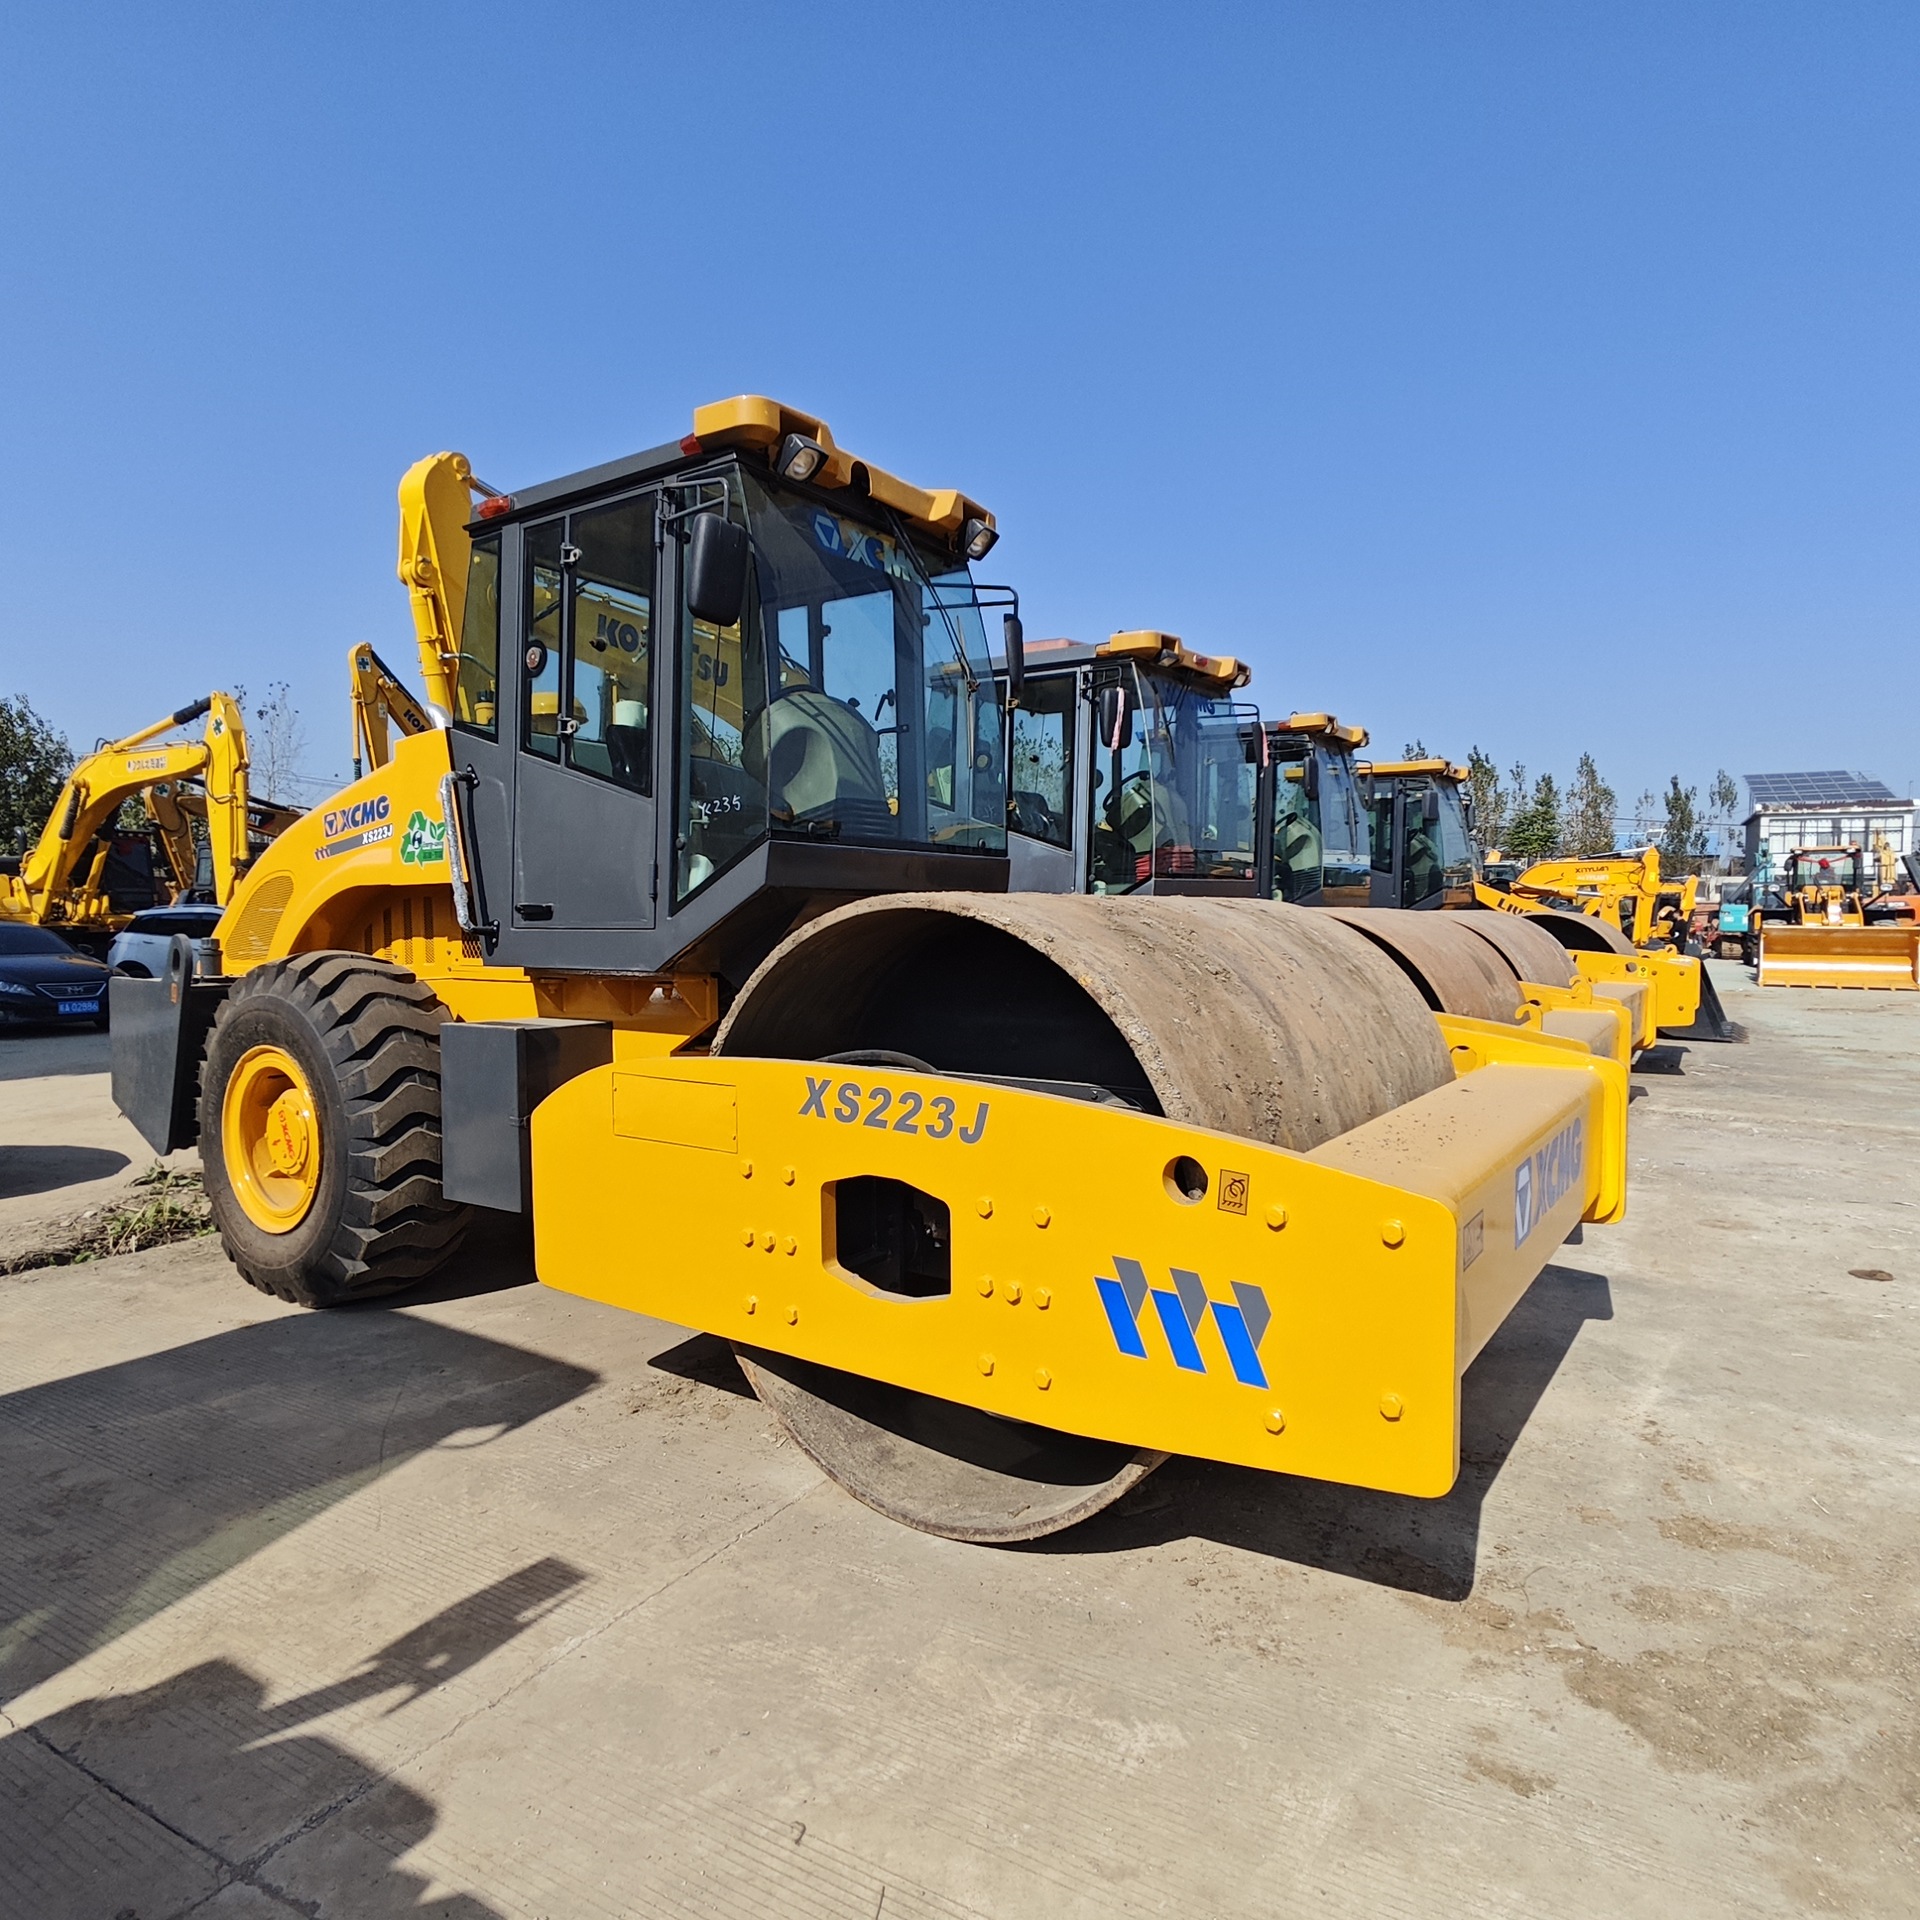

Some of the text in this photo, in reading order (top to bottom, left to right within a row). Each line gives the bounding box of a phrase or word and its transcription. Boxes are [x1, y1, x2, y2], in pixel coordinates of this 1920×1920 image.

[339, 796, 389, 832] XCMG
[362, 825, 393, 845] XS223J
[798, 1076, 990, 1144] XS223J
[1532, 1116, 1583, 1230] XCMG
